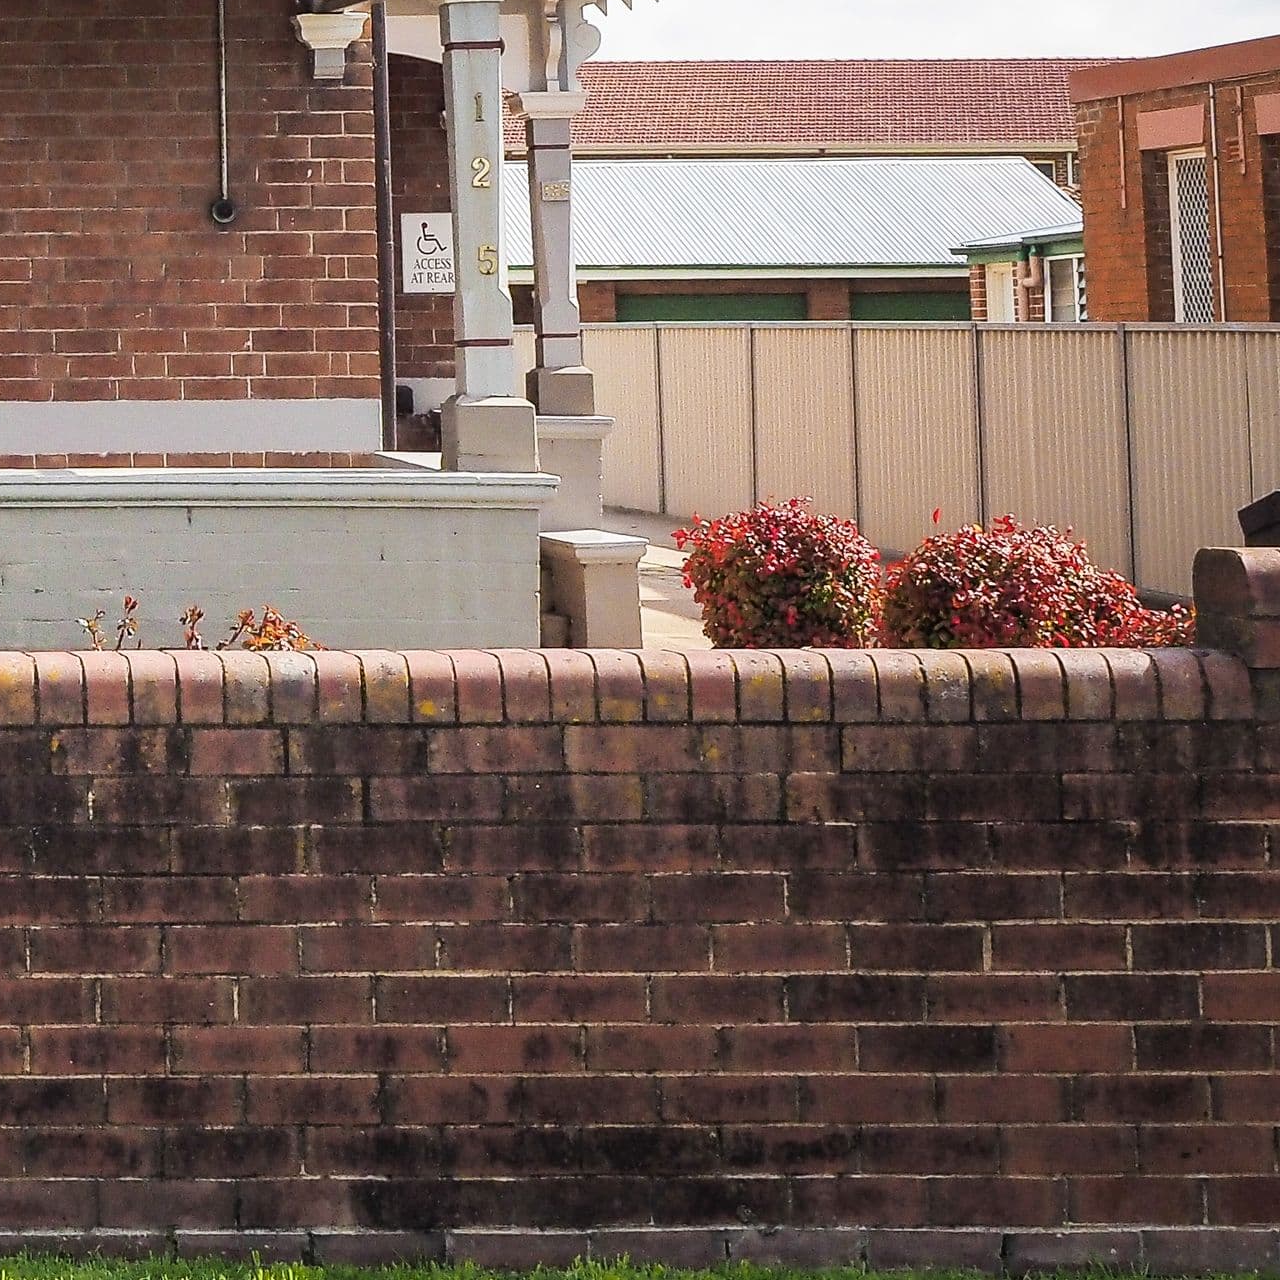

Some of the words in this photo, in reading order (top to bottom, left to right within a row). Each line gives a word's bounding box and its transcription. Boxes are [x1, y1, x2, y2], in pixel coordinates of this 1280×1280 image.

[413, 258, 452, 270] ACCESS
[411, 272, 425, 284] AT
[427, 271, 455, 284] REAR
